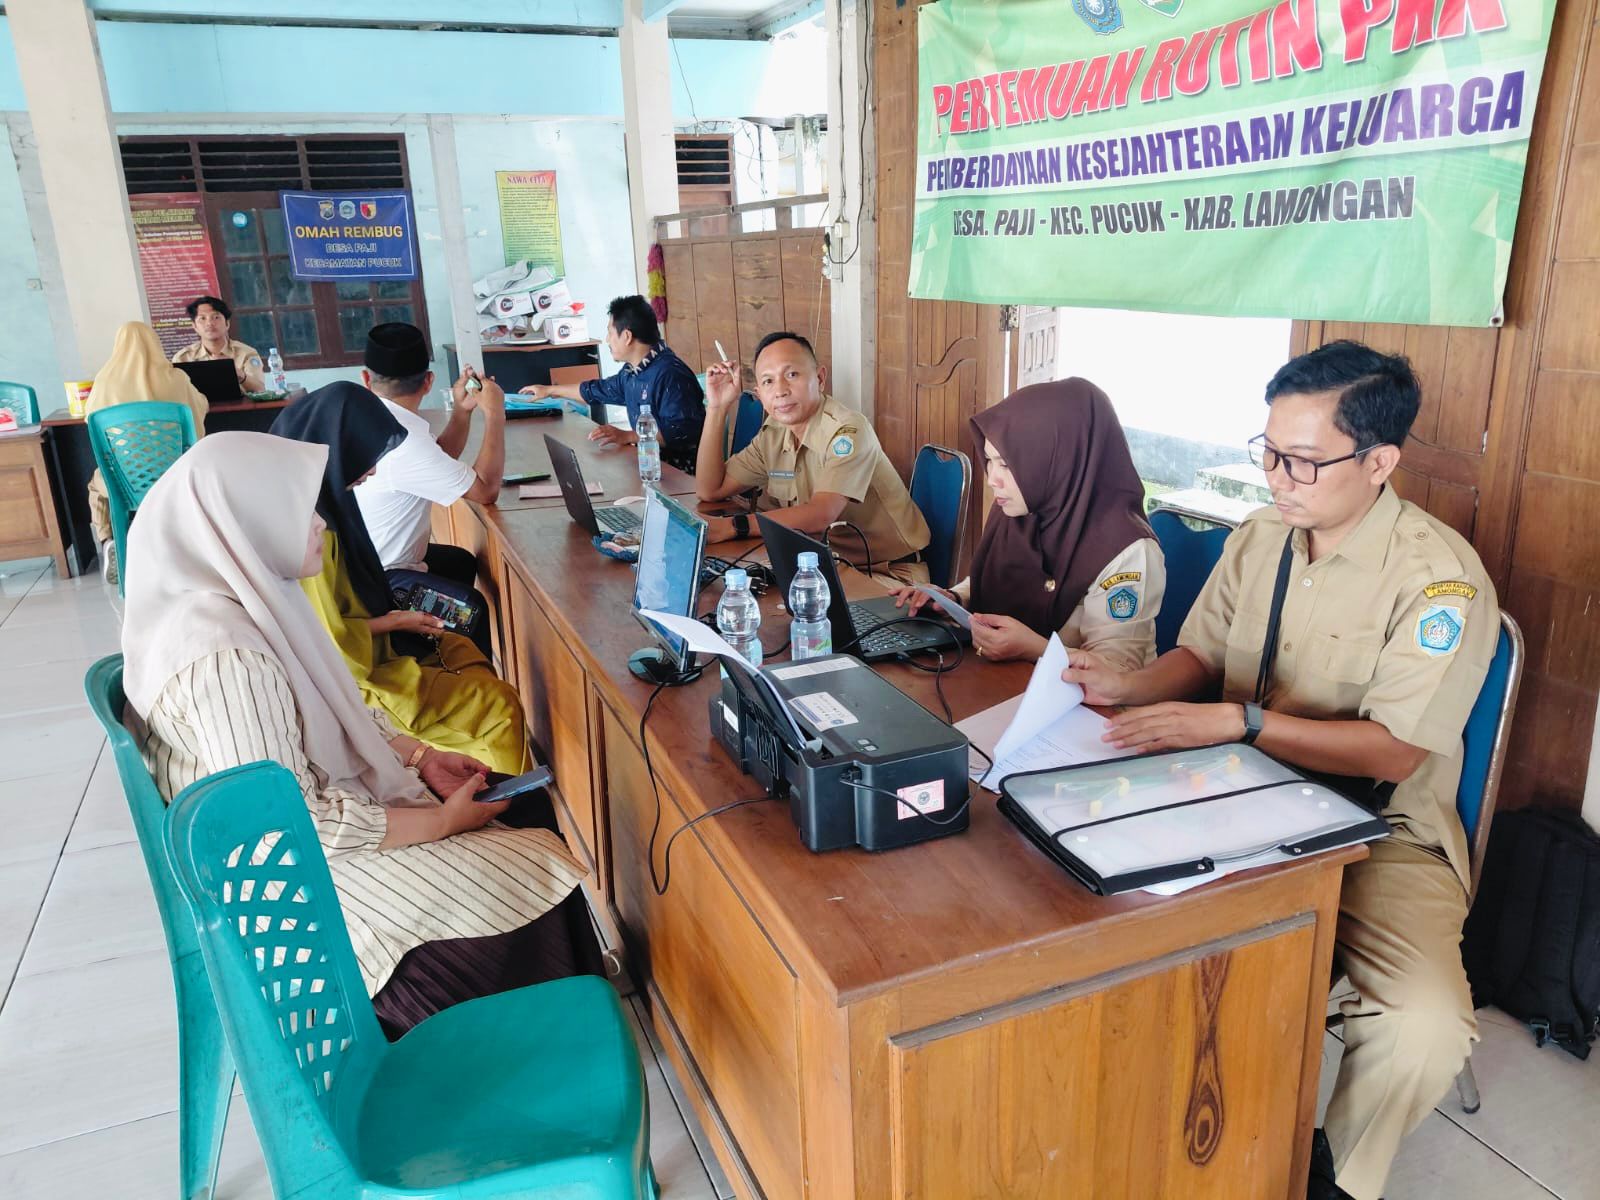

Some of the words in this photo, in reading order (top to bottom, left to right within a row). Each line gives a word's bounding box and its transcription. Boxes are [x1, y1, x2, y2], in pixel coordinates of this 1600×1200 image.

[931, 45, 1147, 136] PERTEMUAN
[1140, 0, 1322, 103] RUTIN
[1066, 111, 1295, 182] KESEJAHTERAAN
[1300, 70, 1525, 156] KELUARGA
[993, 208, 1036, 236] PAJI
[1050, 206, 1089, 236] KEC.
[1090, 200, 1166, 235] PUCUK
[1183, 194, 1237, 231] KAB.
[1242, 175, 1415, 228] LAMONGAN
[295, 226, 340, 238] OMAH
[343, 225, 403, 238] REMBUG
[326, 243, 353, 253] DESA
[354, 243, 377, 253] PAJI
[304, 257, 366, 268] KECAMATAN
[367, 257, 403, 268] PUCUK
